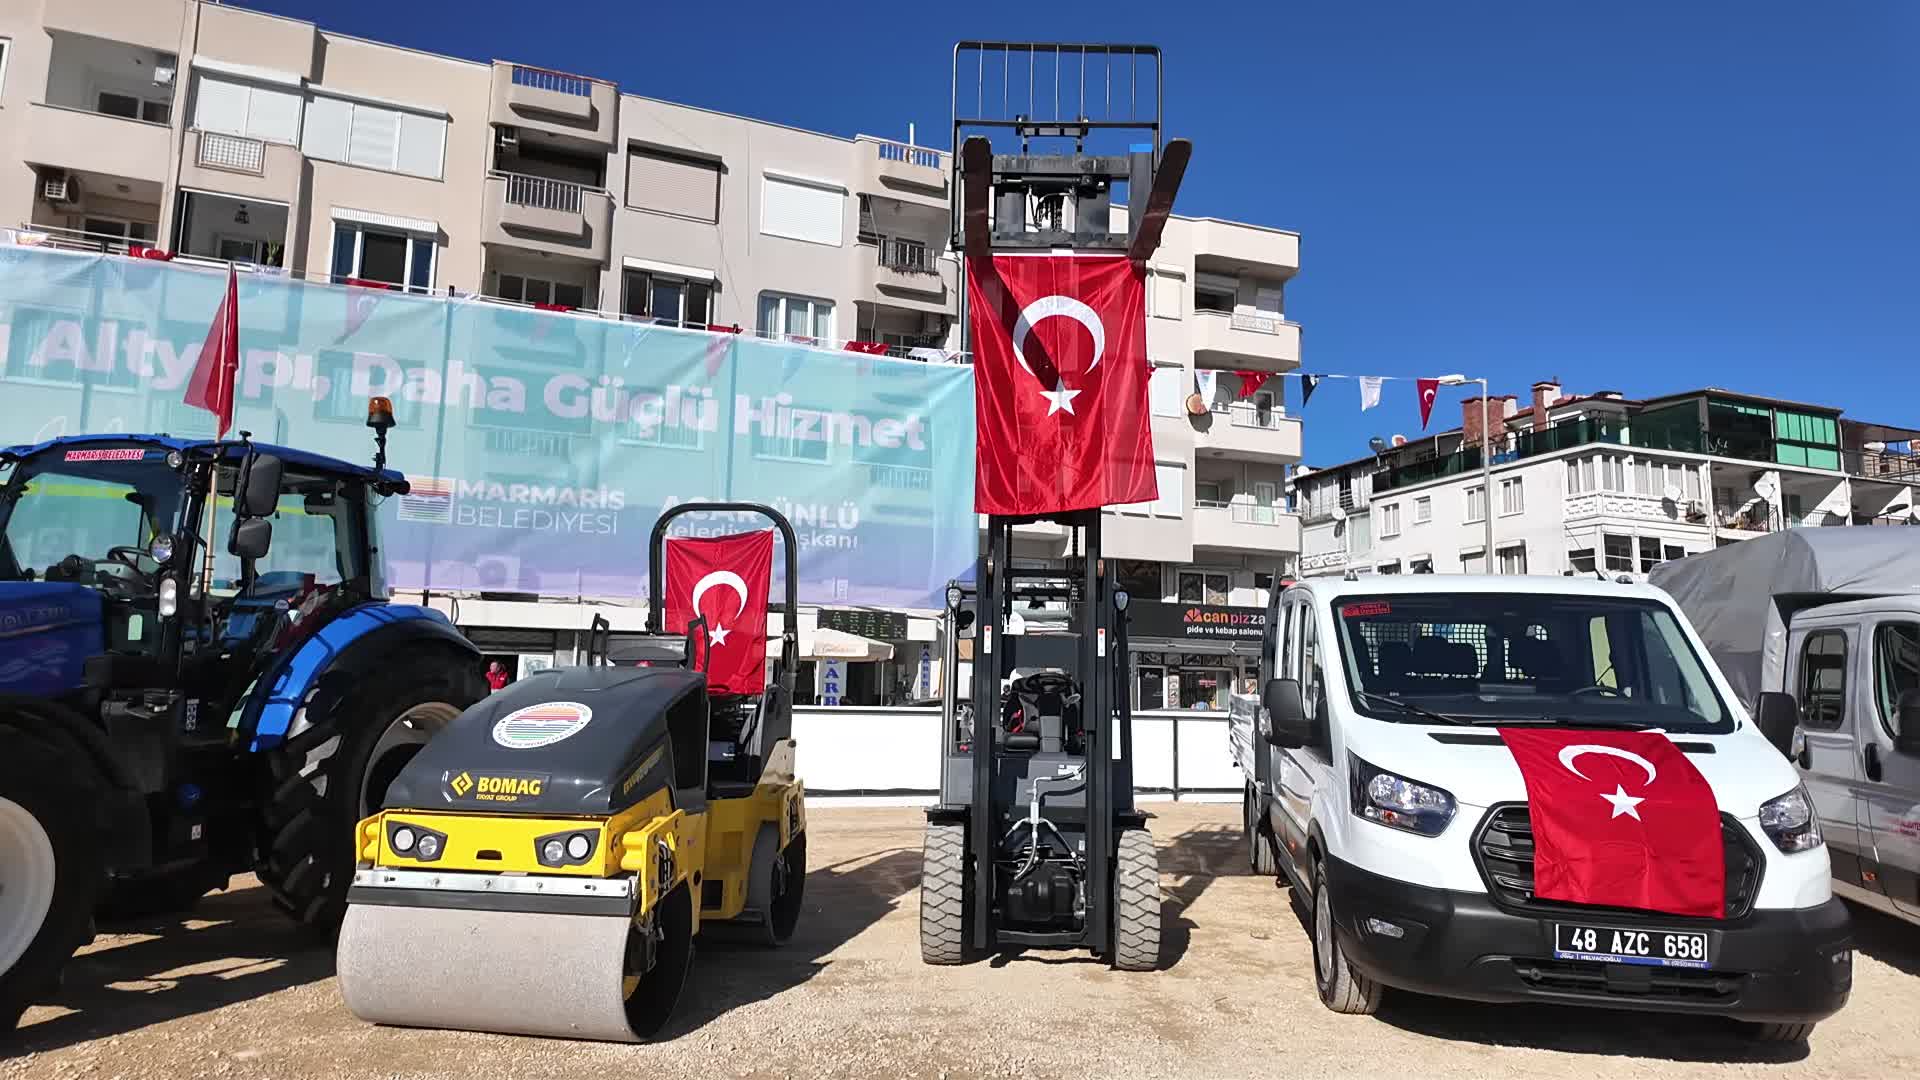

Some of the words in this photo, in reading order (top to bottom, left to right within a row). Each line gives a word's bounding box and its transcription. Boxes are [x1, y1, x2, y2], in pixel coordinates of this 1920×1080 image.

[27, 320, 331, 401] Altypı,
[351, 354, 527, 414] Daha
[543, 372, 720, 438] Güçlü
[734, 392, 926, 451] Hizmet
[458, 479, 625, 510] MARMARİS
[1186, 626, 1204, 635] pide
[1215, 626, 1238, 636] kebap
[1238, 627, 1263, 636] salonu
[477, 776, 541, 795] BOMAG
[1571, 928, 1597, 951] 48
[1610, 930, 1650, 955] AZC
[1664, 934, 1703, 959] 658
